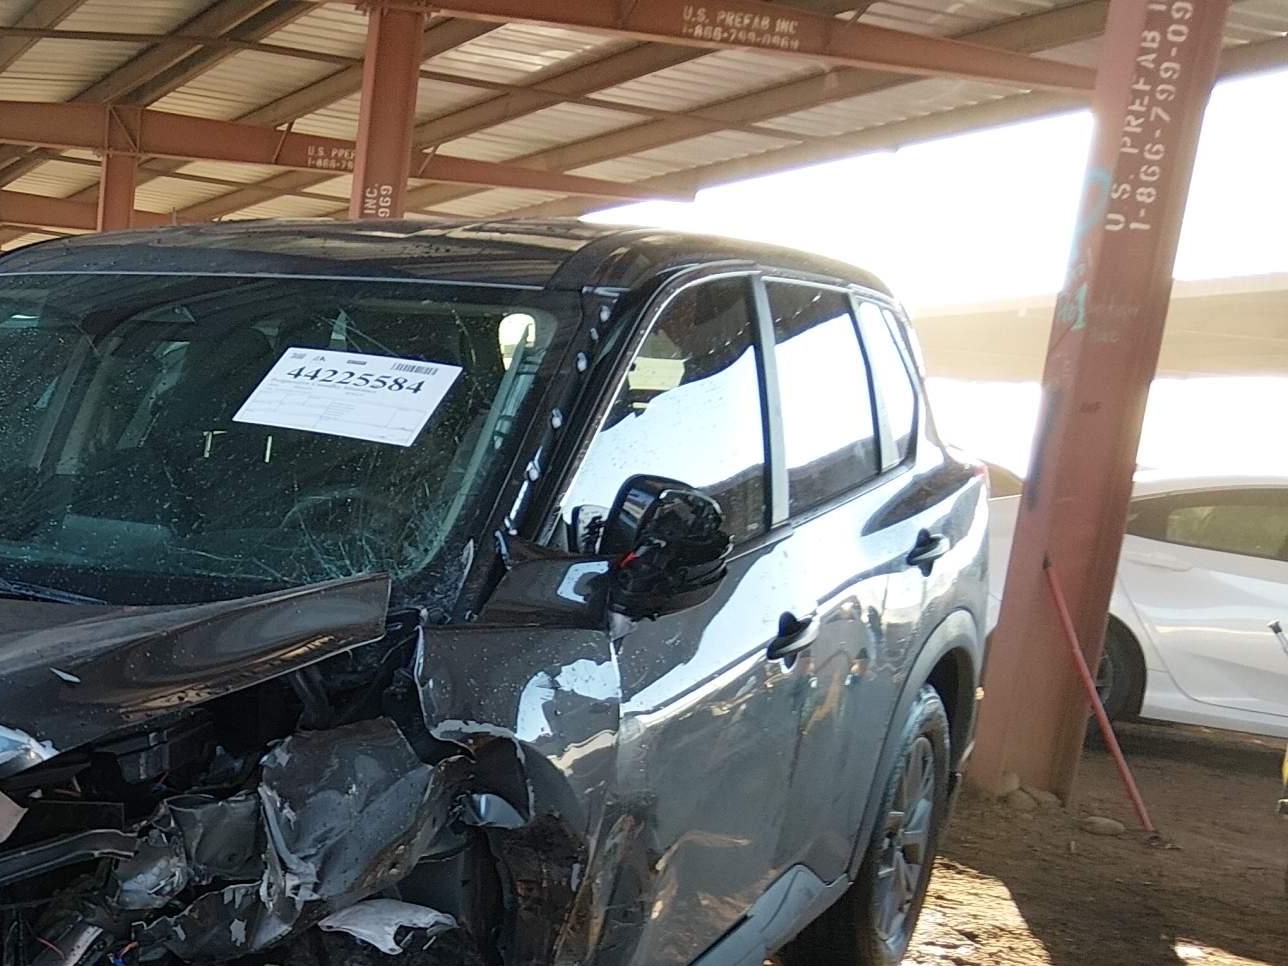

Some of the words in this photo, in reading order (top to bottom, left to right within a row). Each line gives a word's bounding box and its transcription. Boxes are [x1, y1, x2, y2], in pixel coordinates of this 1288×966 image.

[716, 10, 770, 30] PREFAB
[1120, 29, 1161, 154] PREFAB
[1128, 1, 1193, 230] 1-866-799-09
[287, 366, 425, 394] 44225584
